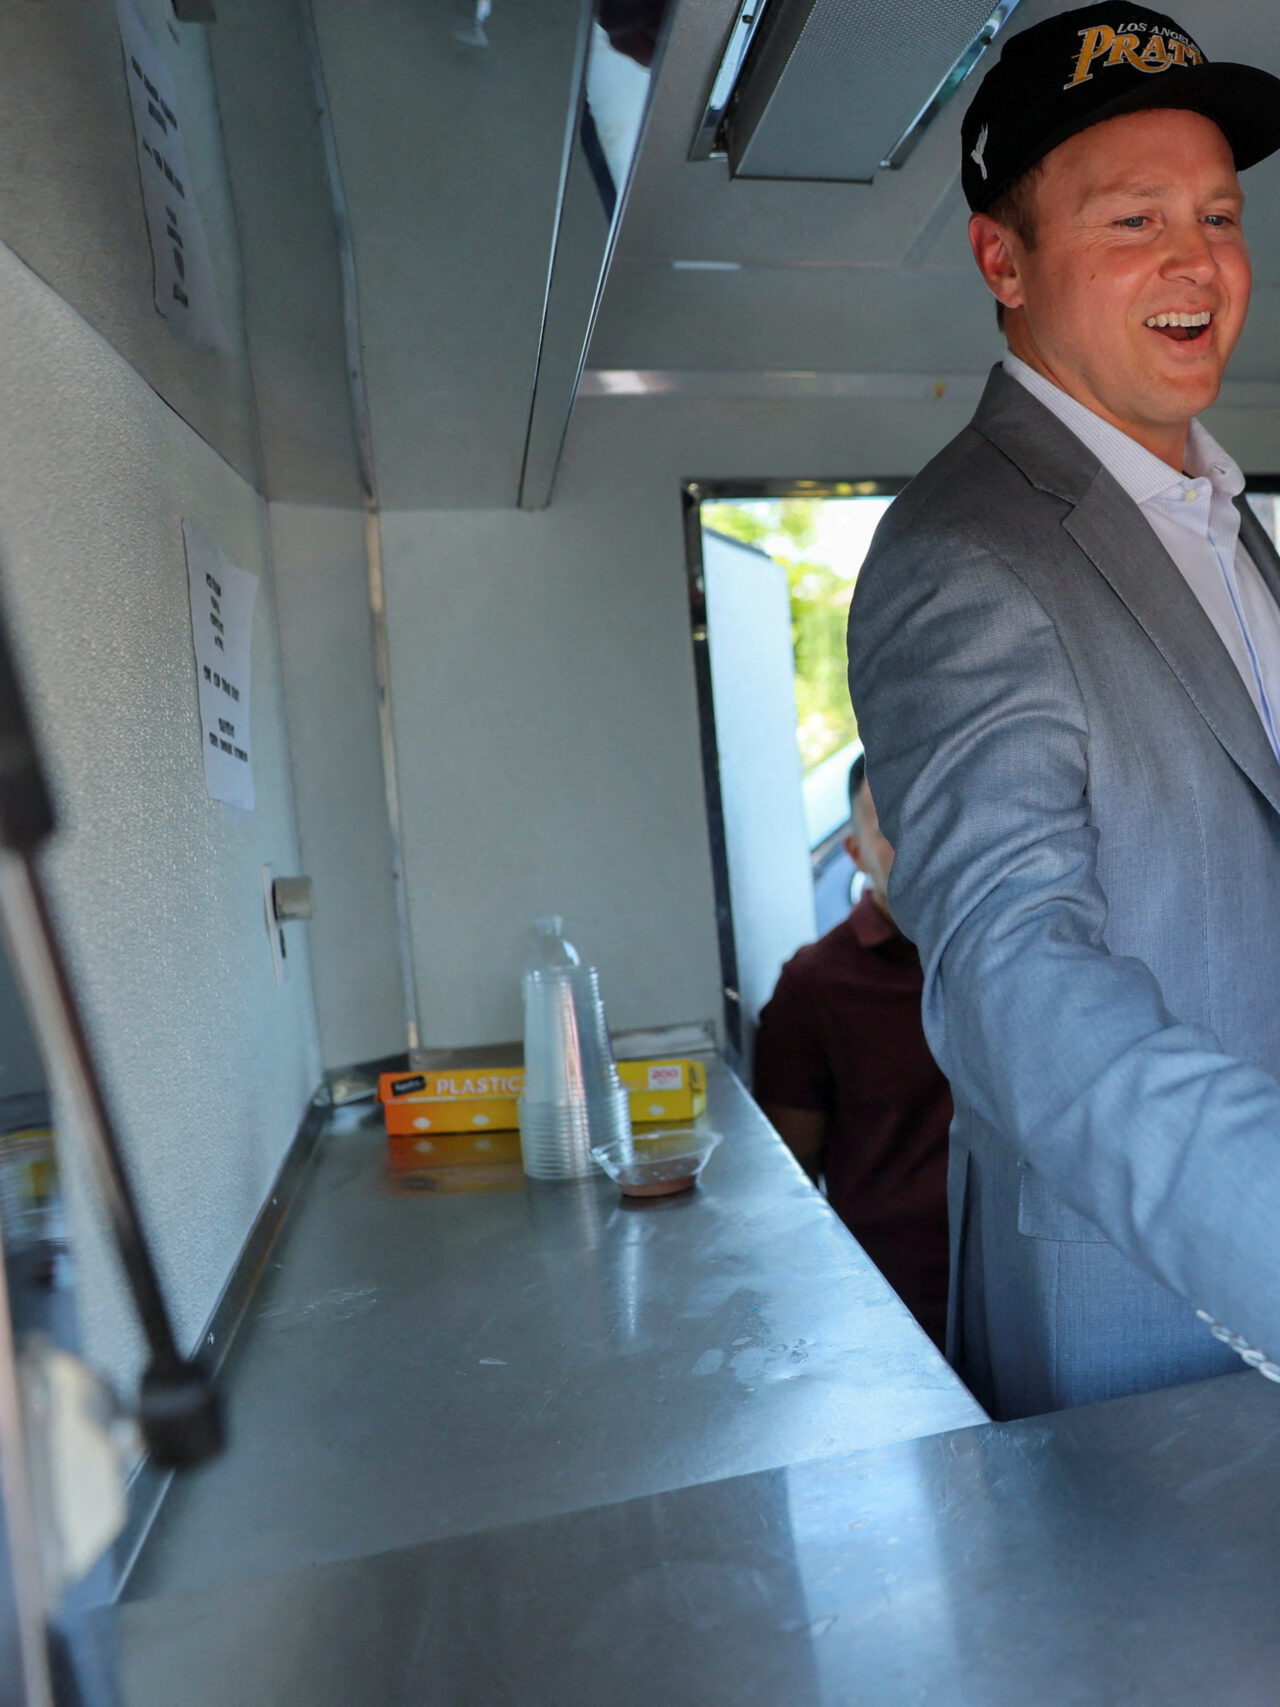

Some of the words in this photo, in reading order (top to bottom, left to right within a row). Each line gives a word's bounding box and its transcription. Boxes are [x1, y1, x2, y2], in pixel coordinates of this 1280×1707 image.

[1117, 22, 1148, 34] LOS
[1063, 24, 1204, 91] PRATT
[436, 1076, 523, 1096] PLASTIC
